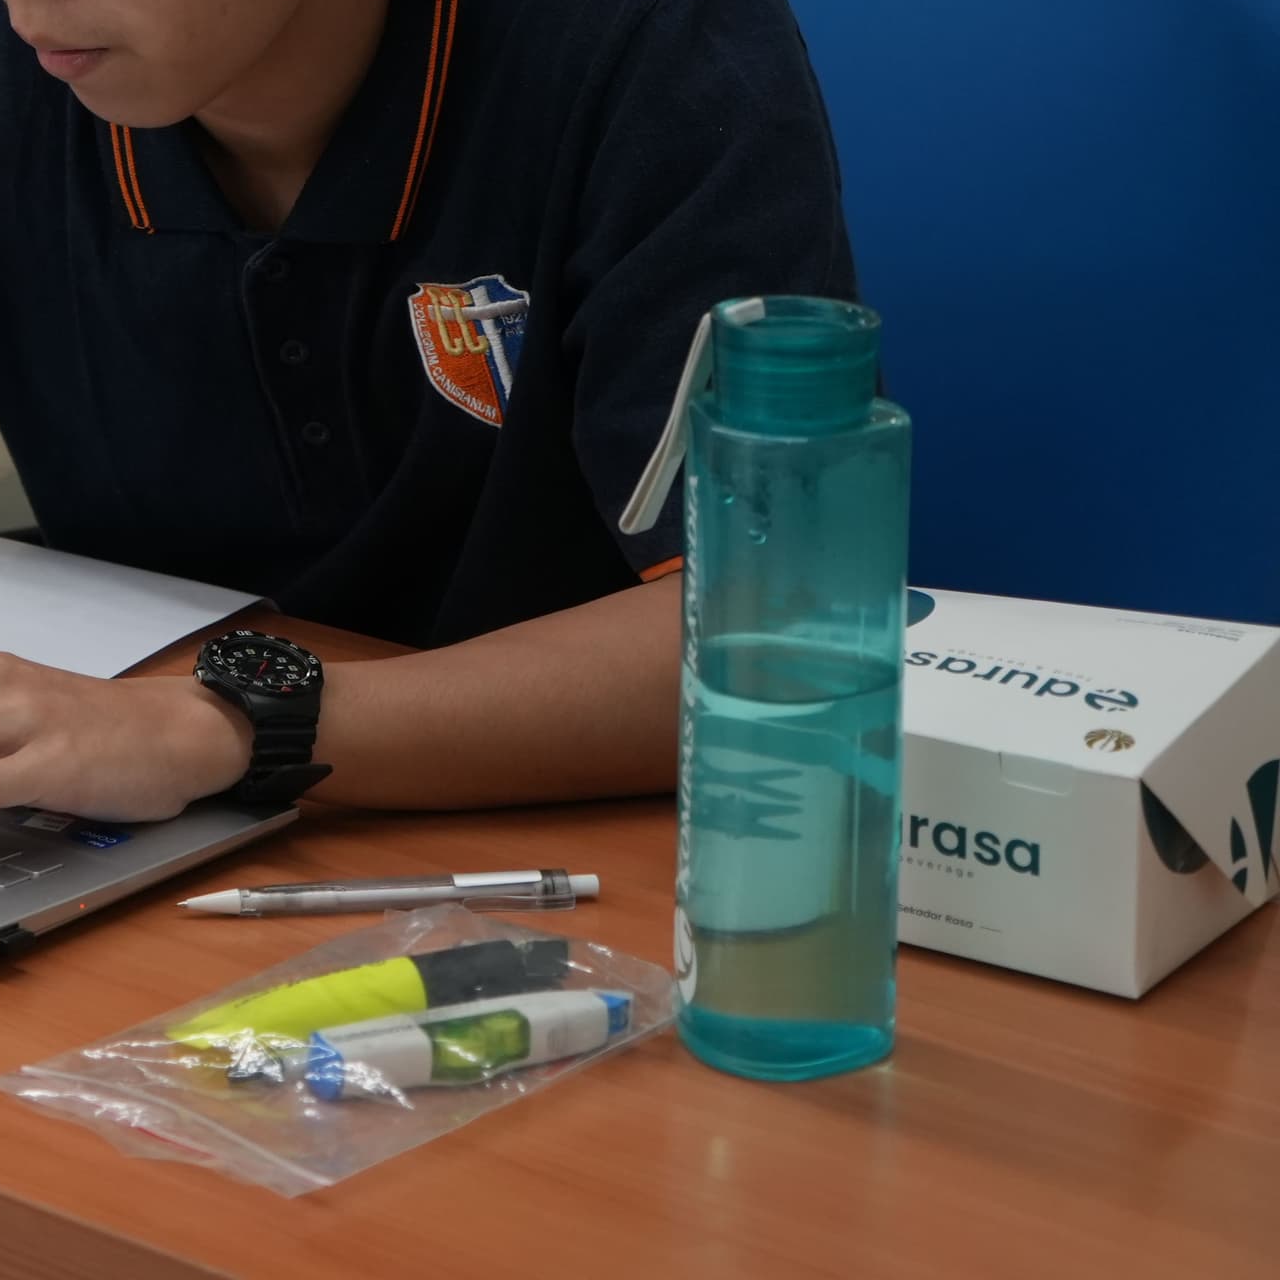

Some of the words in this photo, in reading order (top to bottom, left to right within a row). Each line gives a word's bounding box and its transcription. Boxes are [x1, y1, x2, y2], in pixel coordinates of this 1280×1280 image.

[413, 303, 440, 366] COLLEGIUM
[431, 366, 497, 419] CANISIANUM
[903, 649, 1139, 712] eduras
[900, 812, 1041, 877] rasa
[944, 914, 974, 929] Rasa
